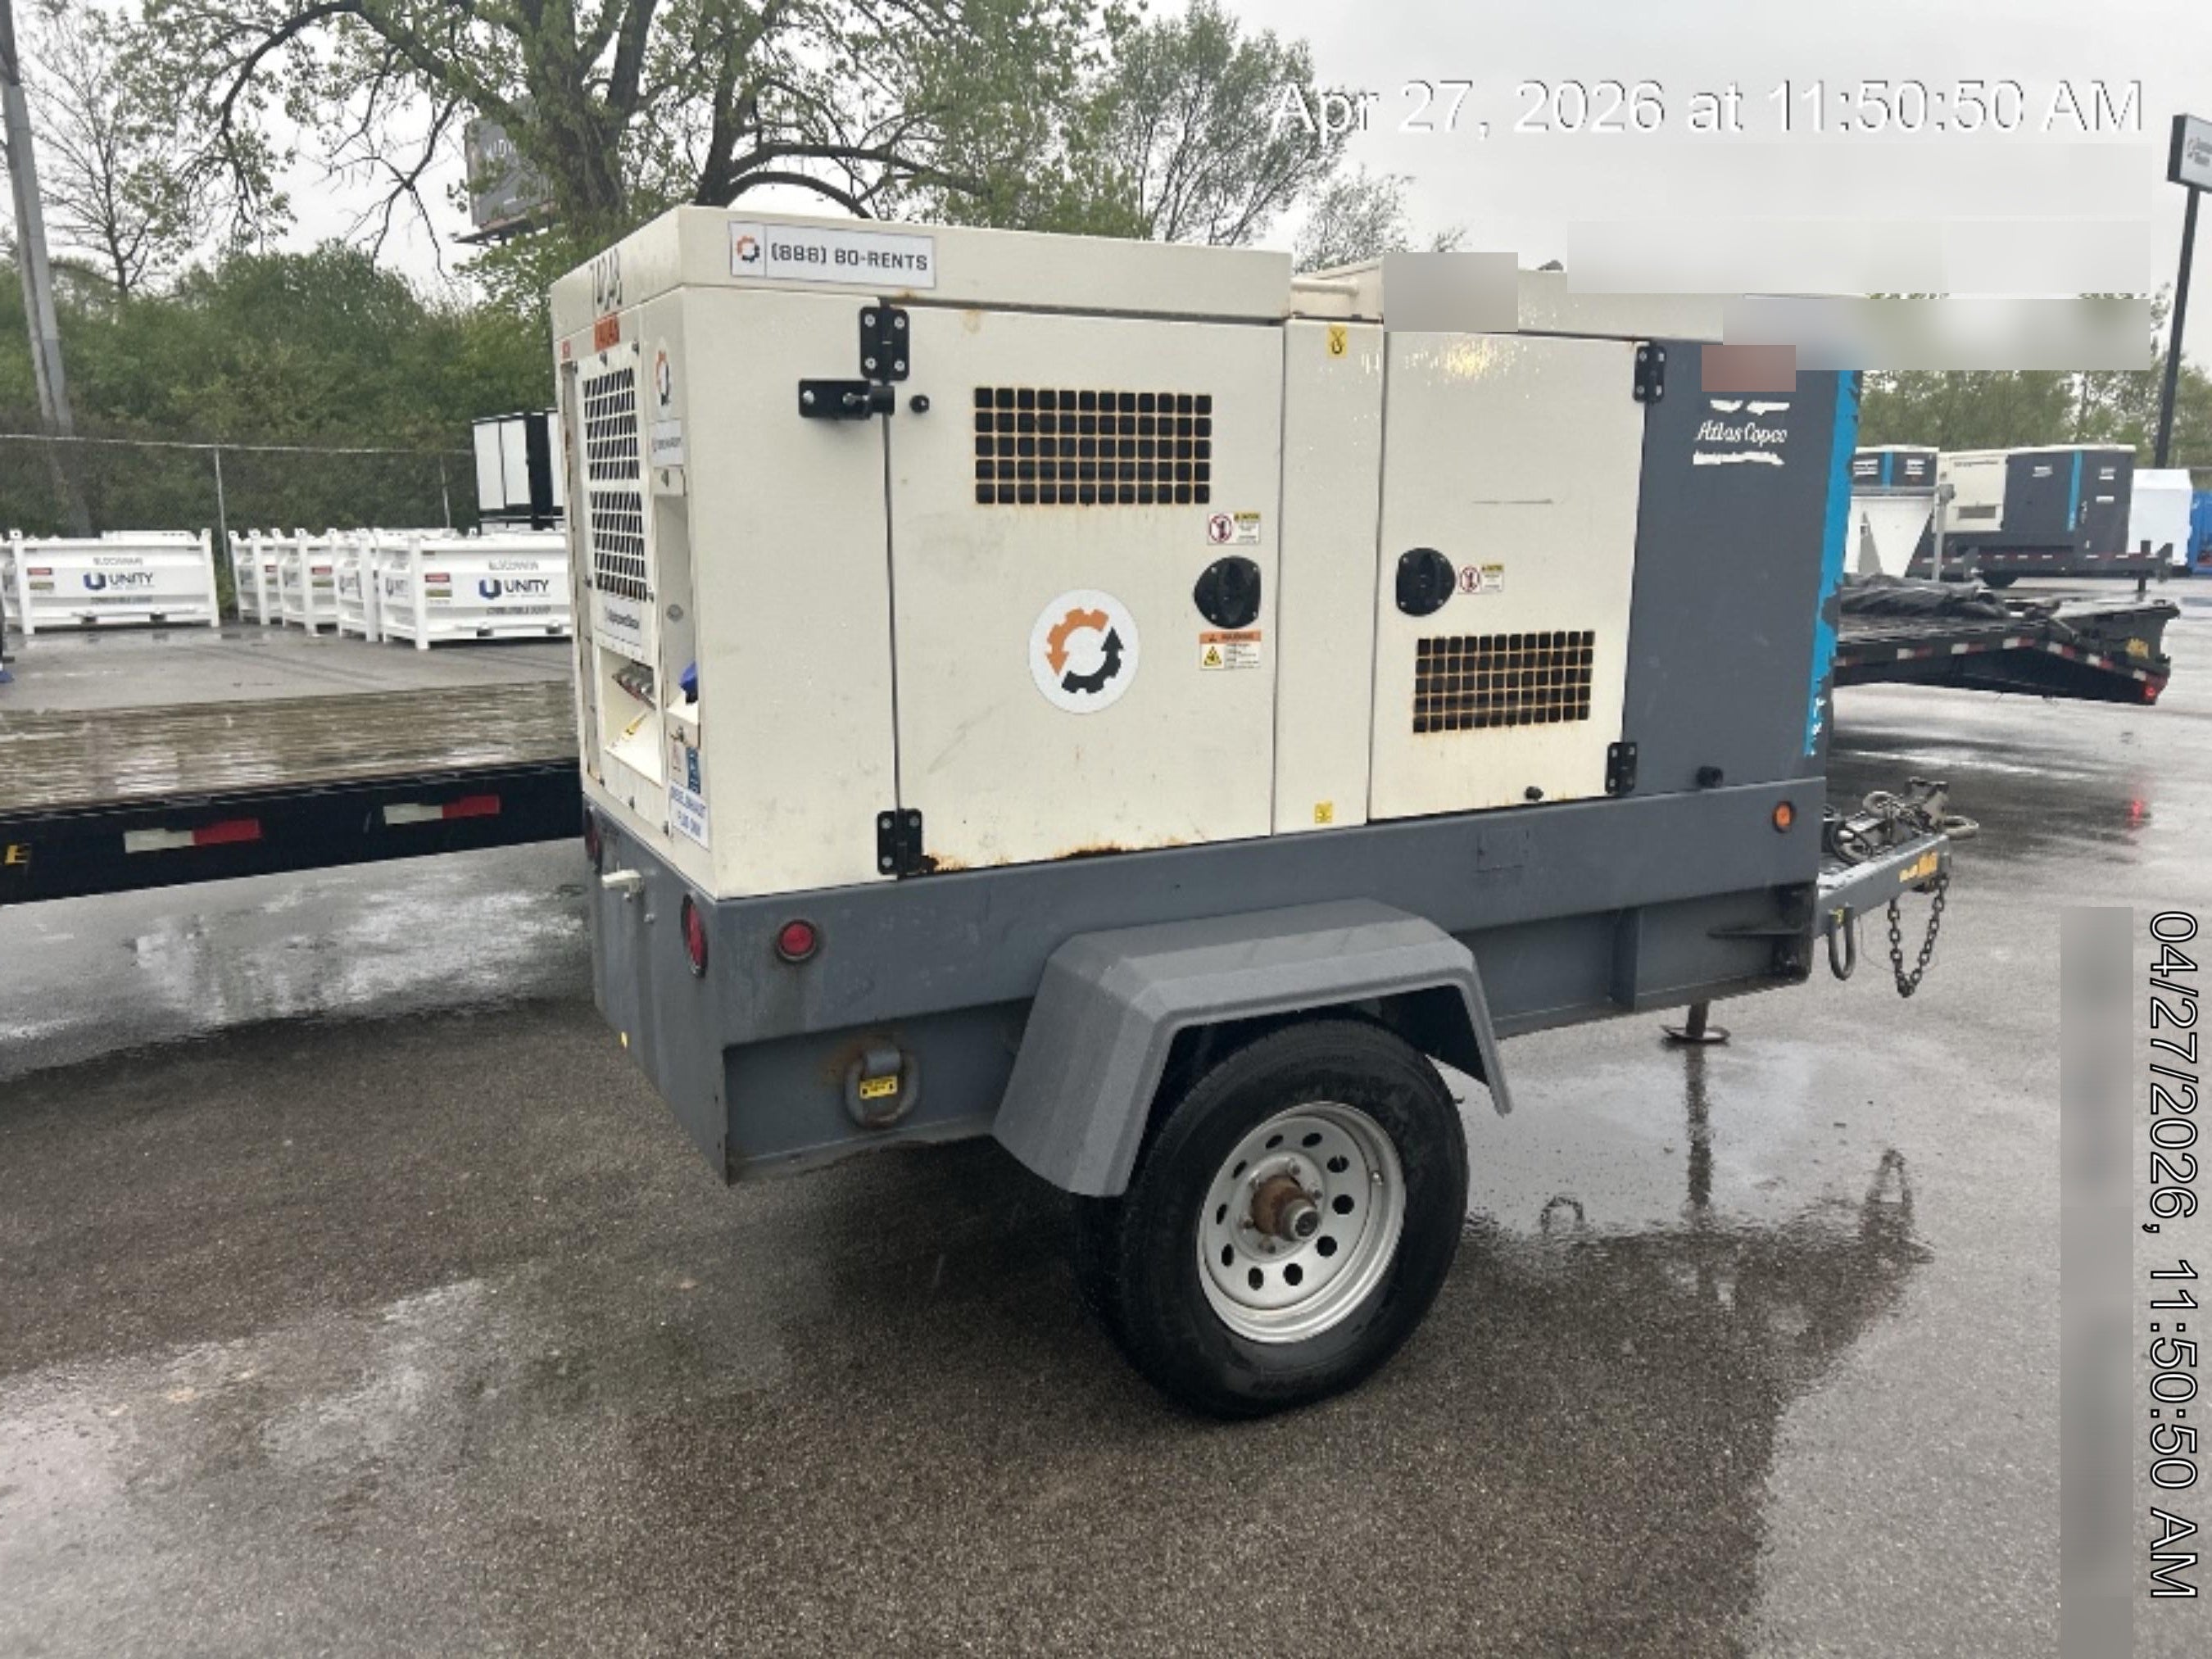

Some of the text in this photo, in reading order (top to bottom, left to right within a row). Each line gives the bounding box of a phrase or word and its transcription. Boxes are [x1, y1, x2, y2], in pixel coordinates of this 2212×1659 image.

[1696, 419, 1743, 442] Atlas
[110, 572, 153, 585] UNITY
[505, 579, 549, 592] UNITY
